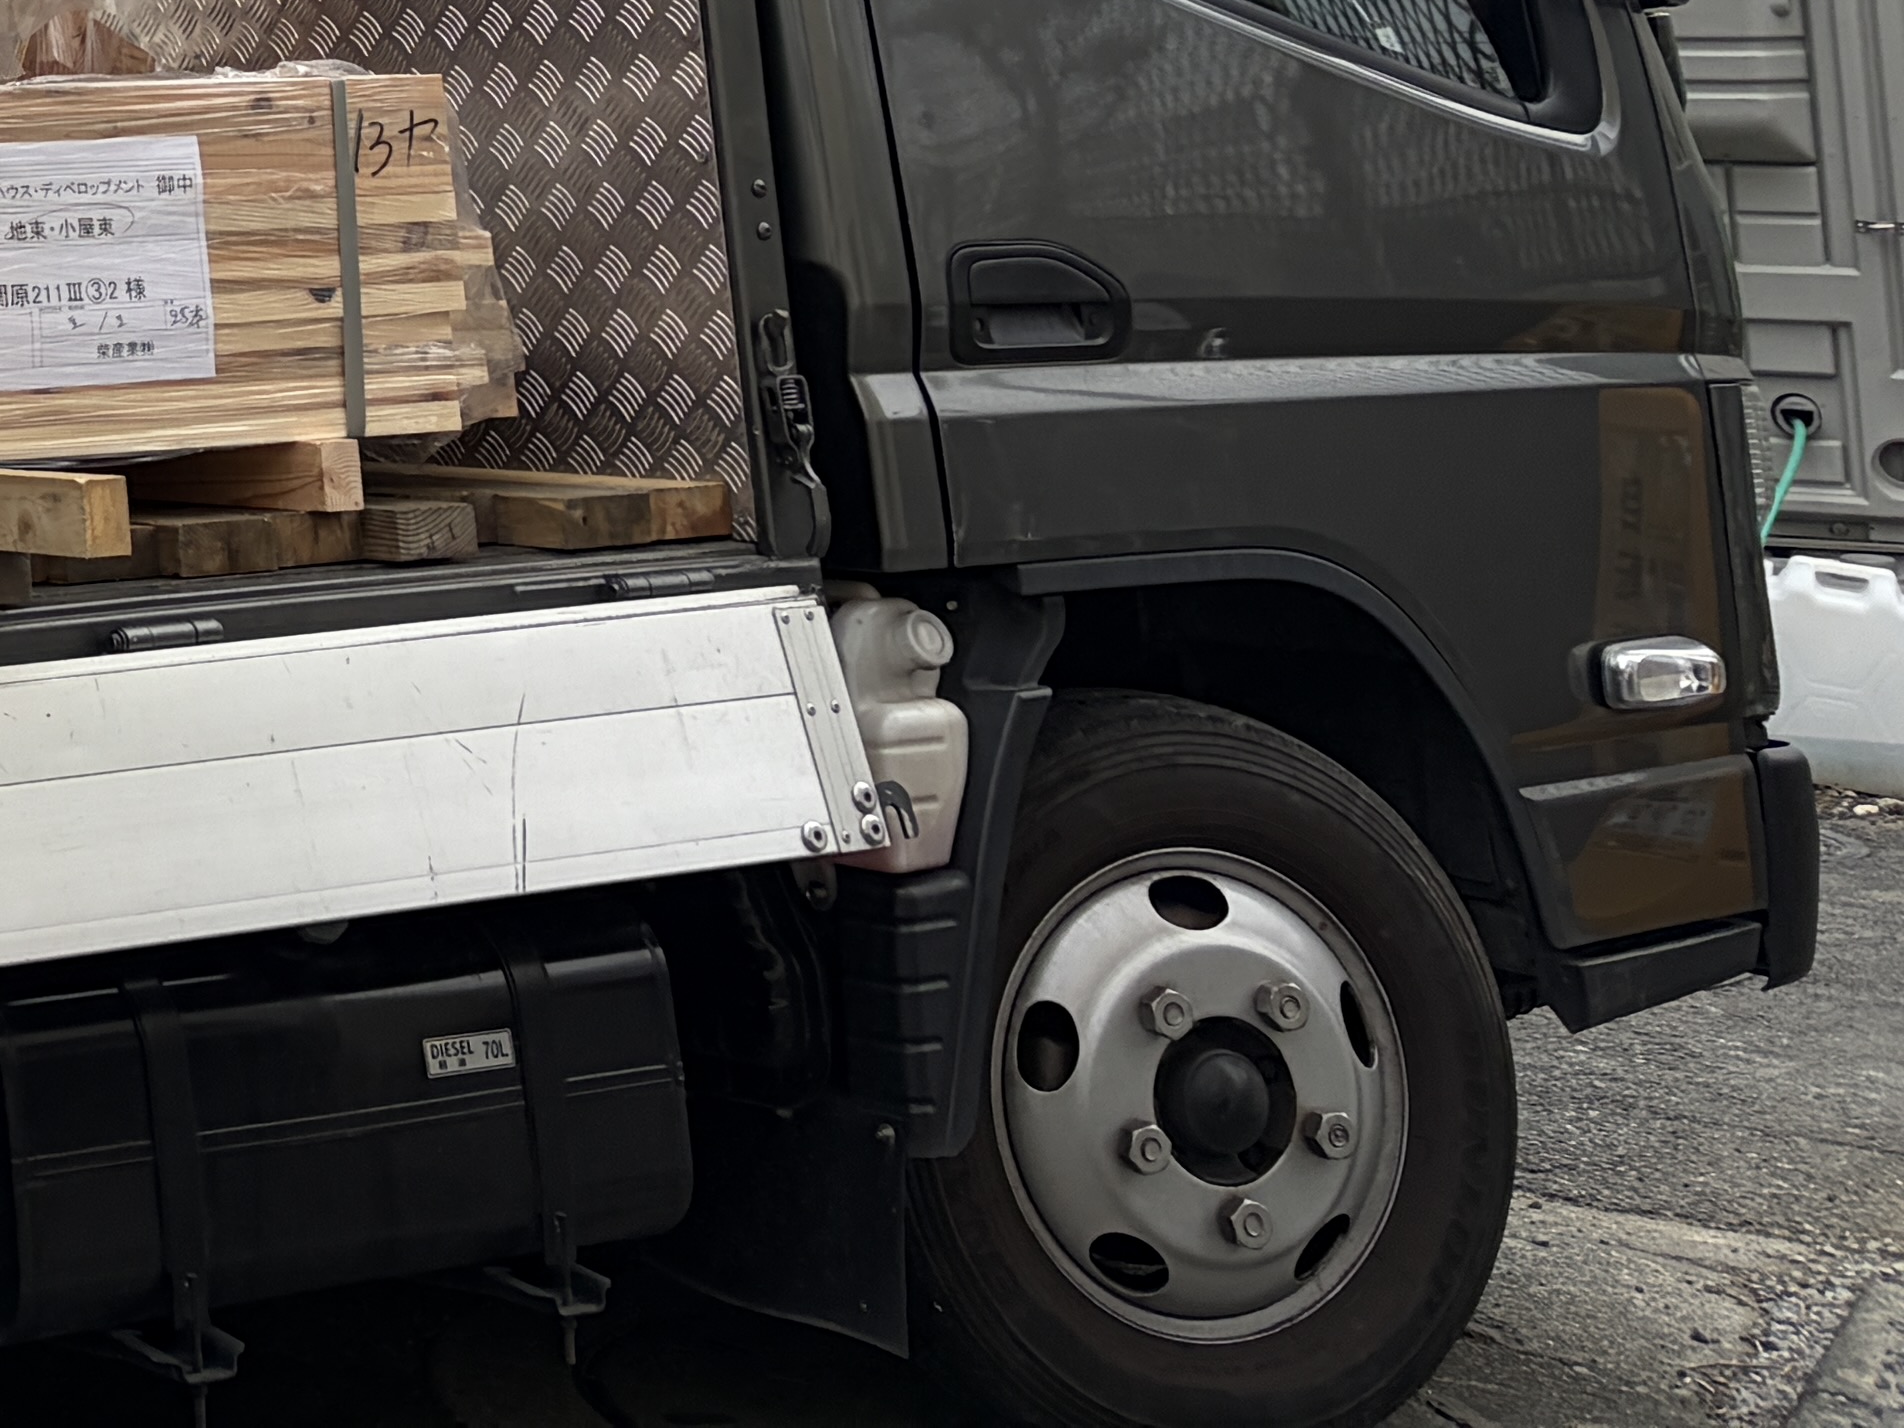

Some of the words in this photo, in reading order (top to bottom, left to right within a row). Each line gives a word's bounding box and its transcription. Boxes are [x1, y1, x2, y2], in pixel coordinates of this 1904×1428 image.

[156, 175, 194, 195] 御中
[430, 1040, 474, 1059] DIESEL
[482, 1040, 509, 1059] 70L
